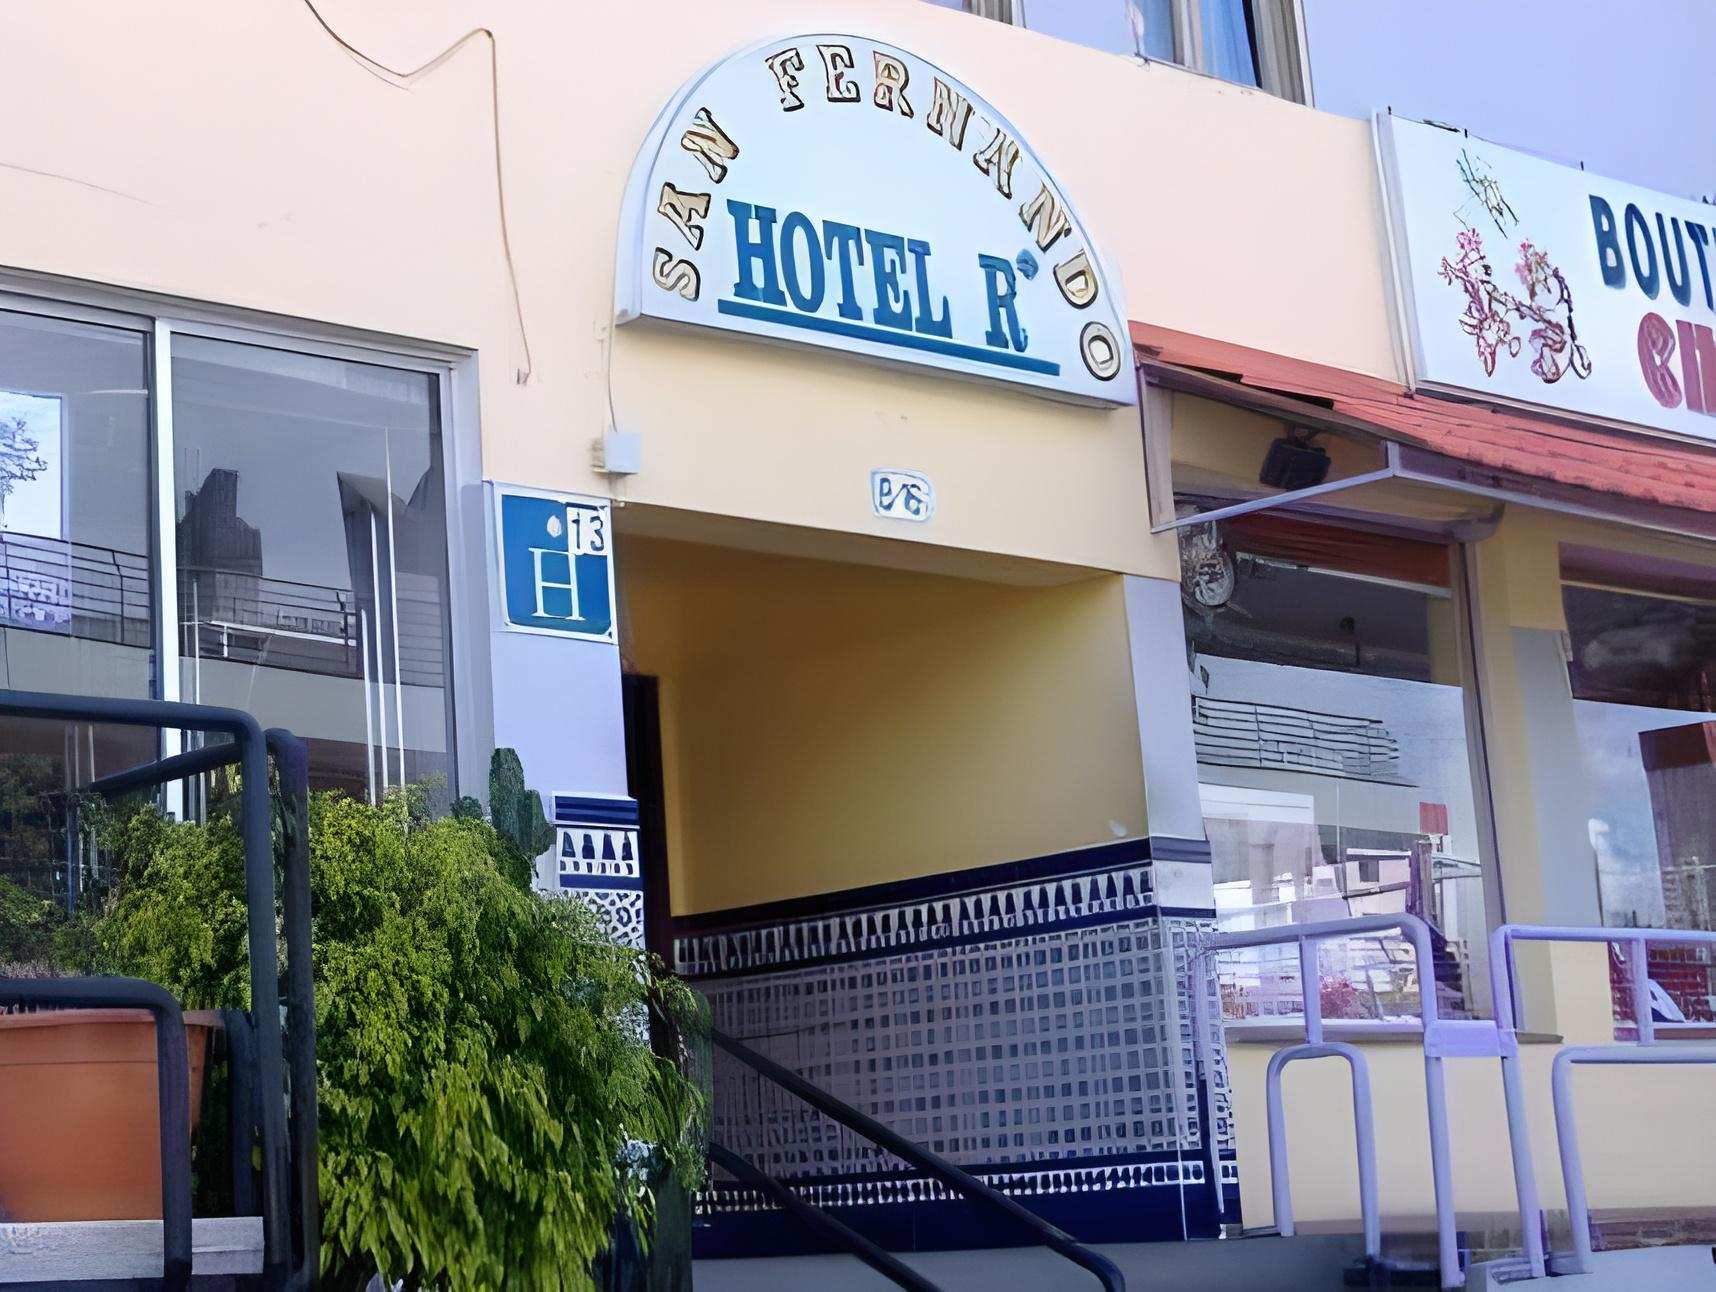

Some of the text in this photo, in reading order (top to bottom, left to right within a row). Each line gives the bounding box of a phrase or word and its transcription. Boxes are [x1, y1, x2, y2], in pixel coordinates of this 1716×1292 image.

[654, 44, 1122, 382] SAN FERNANDO
[726, 198, 953, 339] HOTEL
[528, 547, 586, 621] H
